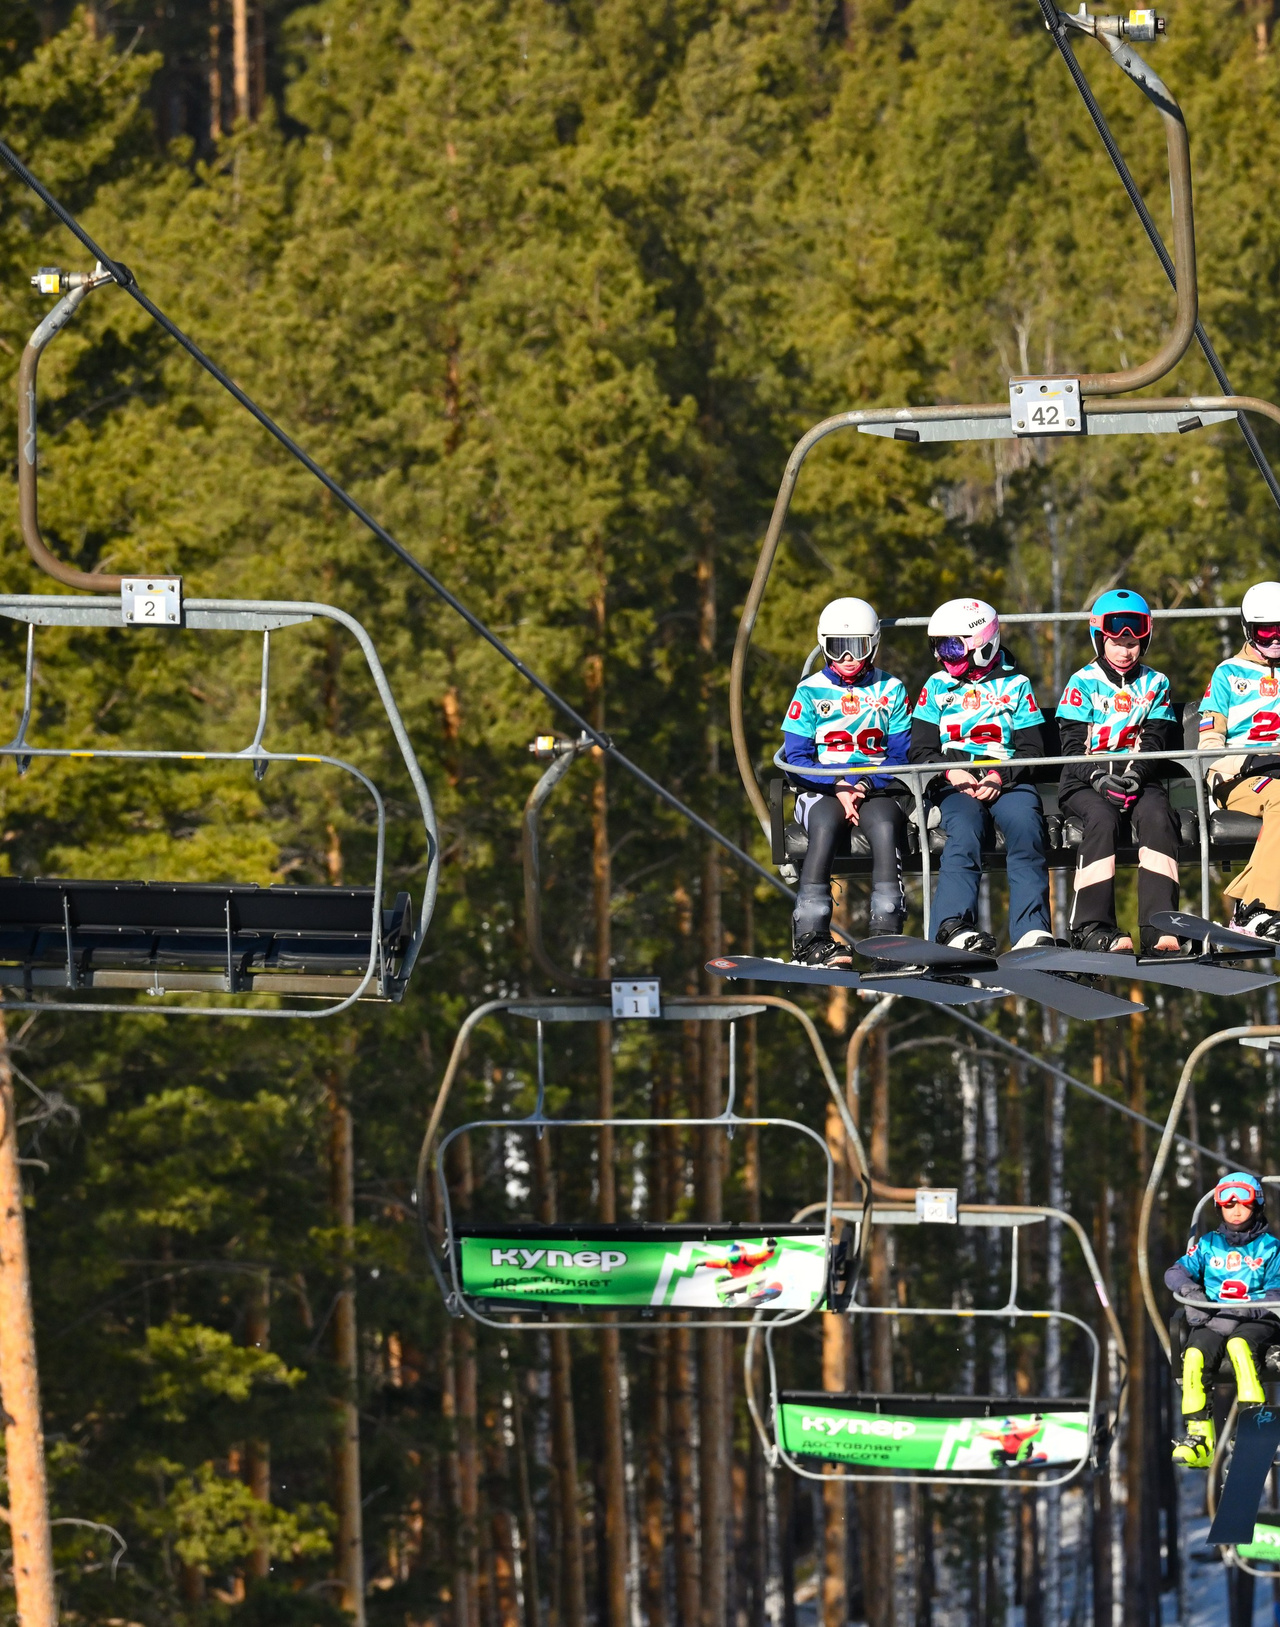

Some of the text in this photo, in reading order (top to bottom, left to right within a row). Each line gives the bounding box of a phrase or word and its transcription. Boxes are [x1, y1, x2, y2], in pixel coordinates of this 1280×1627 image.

[1031, 405, 1060, 426] 42
[144, 600, 156, 617] 2
[968, 617, 987, 629] uvex
[916, 686, 929, 707] 8
[1060, 686, 1084, 708] 16
[787, 700, 803, 721] 0
[823, 727, 886, 756] 20
[633, 1000, 639, 1013] 1
[490, 1247, 629, 1272] купер
[1218, 1279, 1251, 1302] 2
[801, 1415, 917, 1441] купер
[801, 1440, 903, 1453] доставляет
